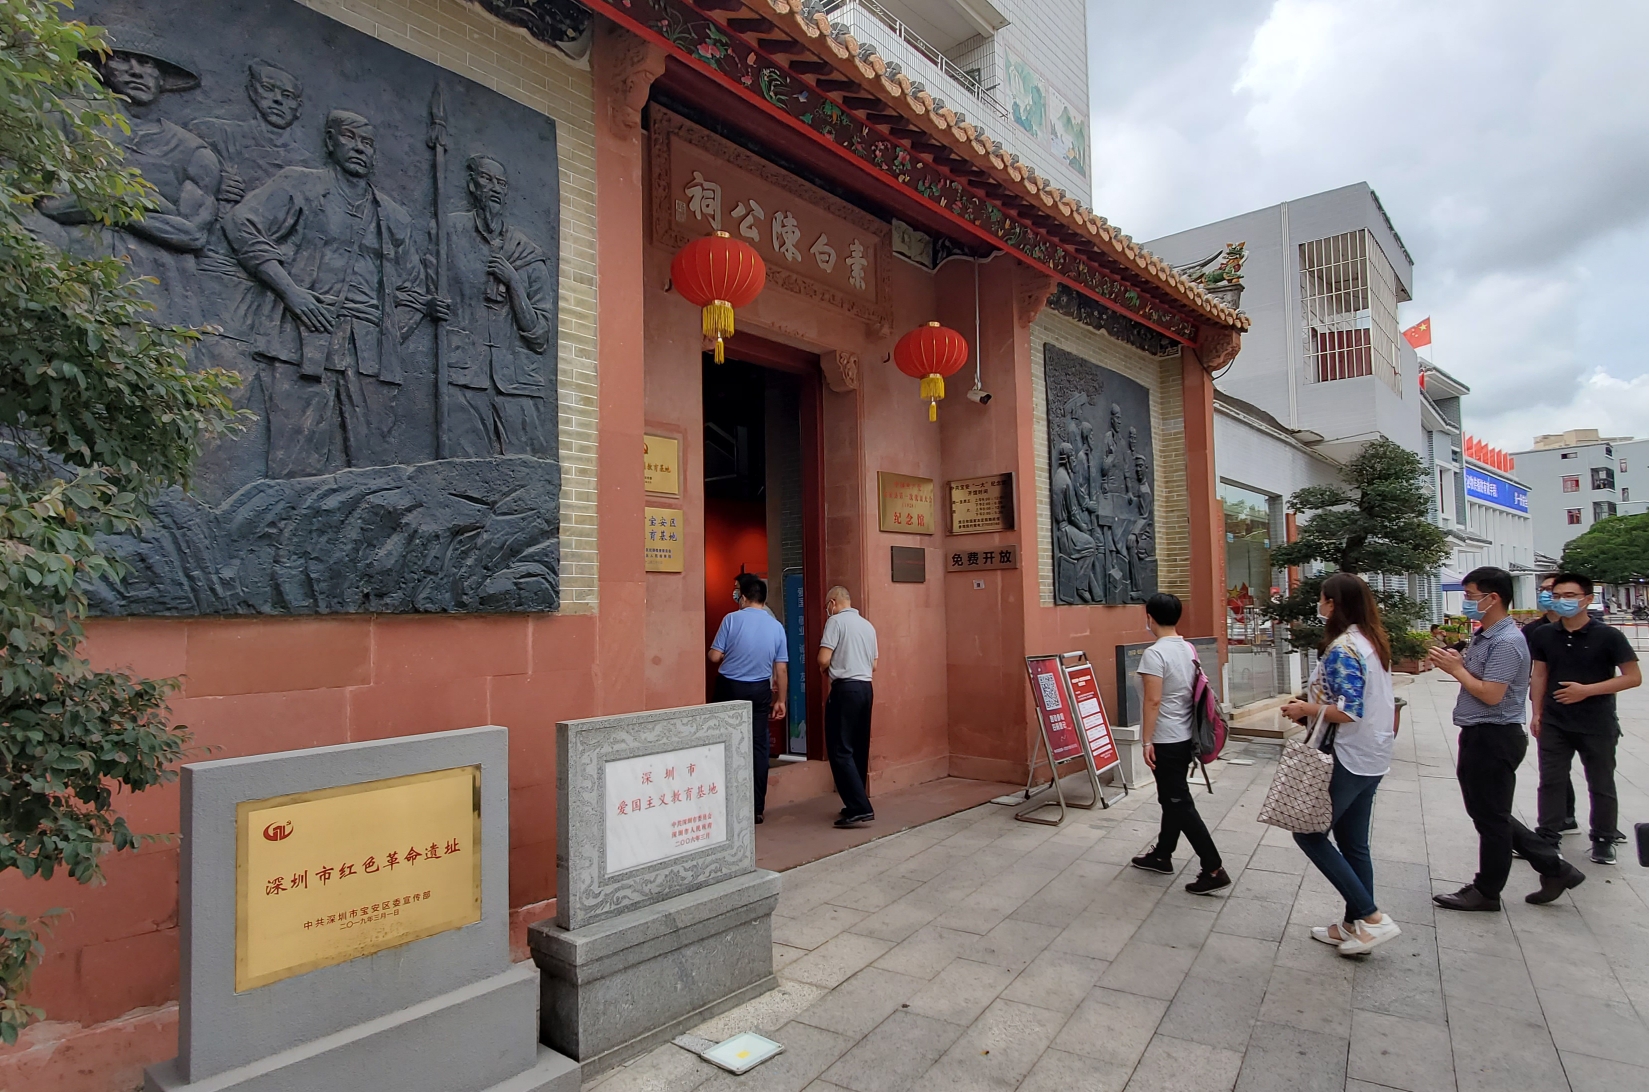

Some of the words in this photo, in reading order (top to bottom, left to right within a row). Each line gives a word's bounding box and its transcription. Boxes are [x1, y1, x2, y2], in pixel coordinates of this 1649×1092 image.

[644, 462, 671, 473] 教育基地
[645, 516, 676, 527] 宝安区
[893, 512, 925, 527] 纪念馆
[645, 530, 677, 541] 育基地
[952, 550, 1012, 567] 免费开放
[641, 763, 696, 785] 深圳市
[617, 782, 718, 816] 爱国主义教育基地
[265, 837, 461, 896] 深圳市红色革命遗址
[303, 890, 431, 930] 中共深圳市宝安区委宣传部
